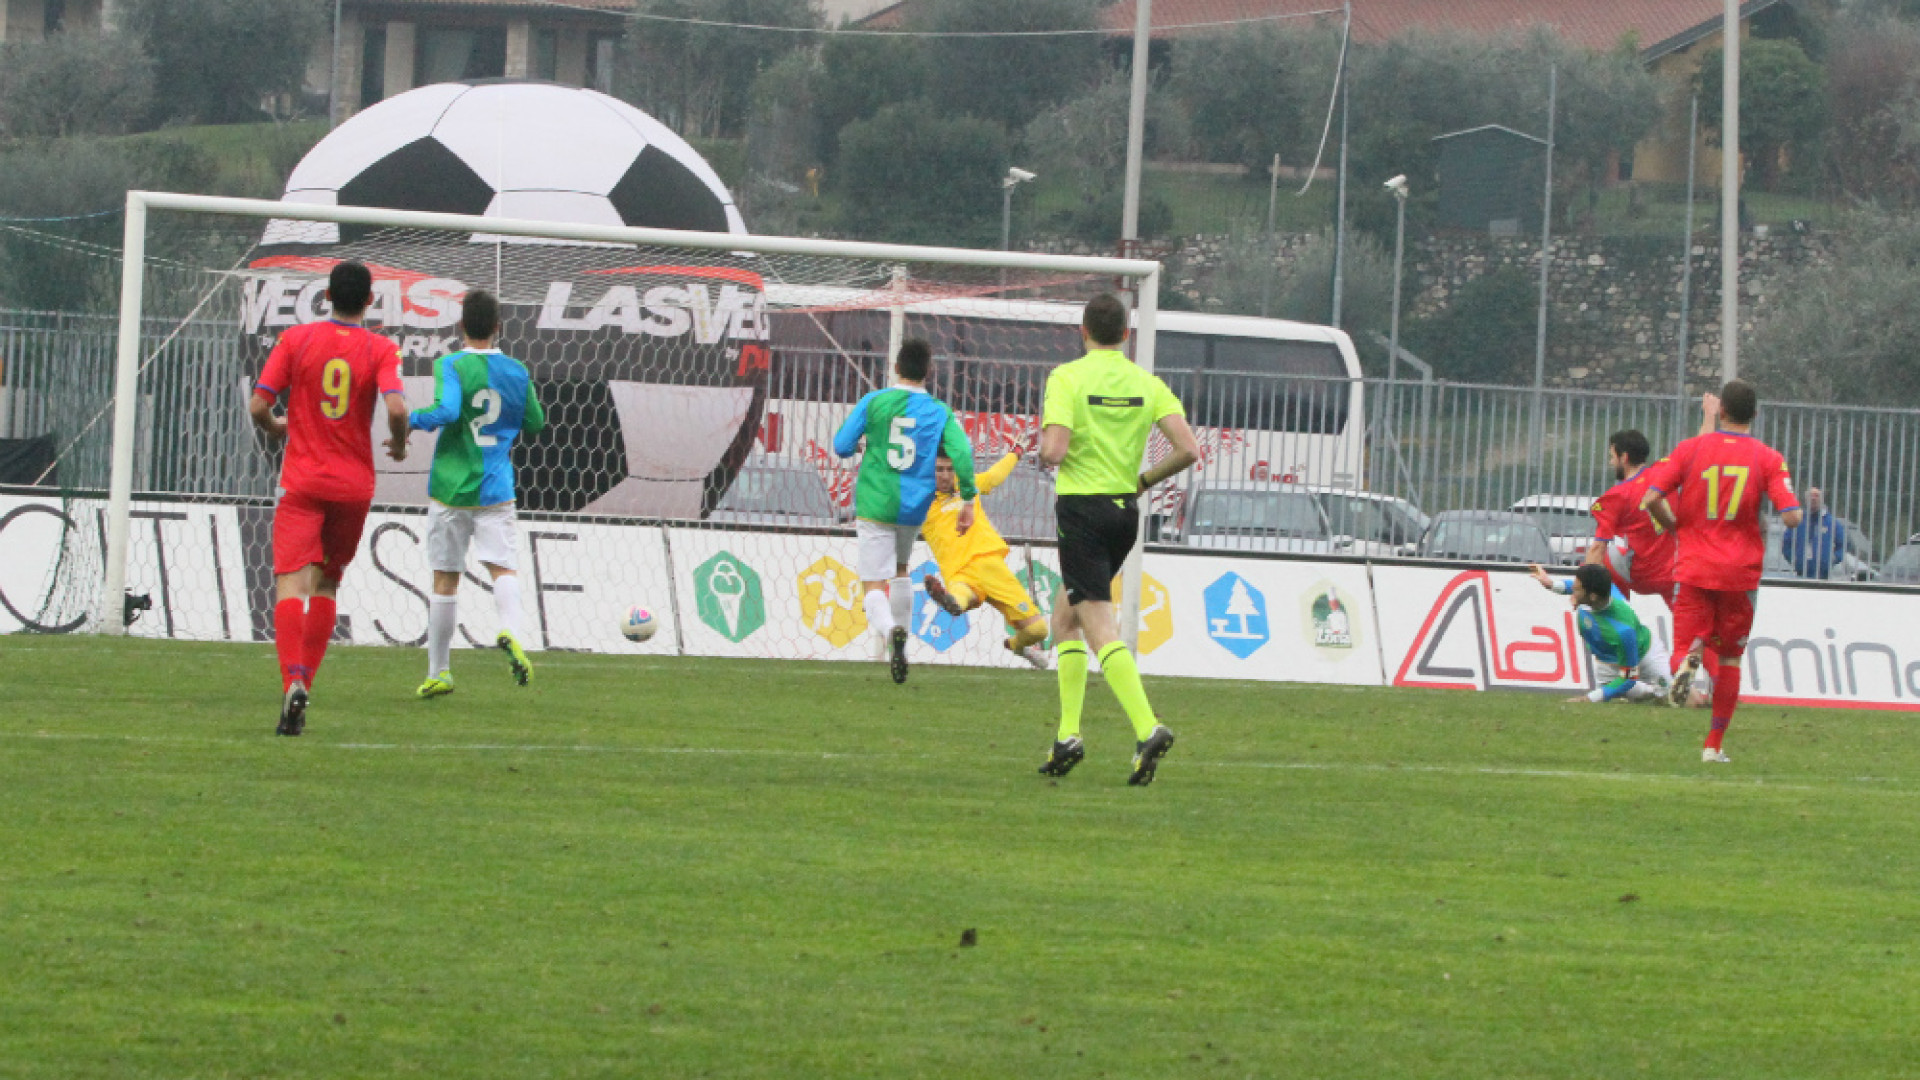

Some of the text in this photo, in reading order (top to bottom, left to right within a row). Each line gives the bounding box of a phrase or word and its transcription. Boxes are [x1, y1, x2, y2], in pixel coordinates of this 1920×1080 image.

[320, 357, 351, 420] 9
[469, 388, 502, 447] 2
[887, 417, 917, 471] 5
[1701, 465, 1750, 521] 17
